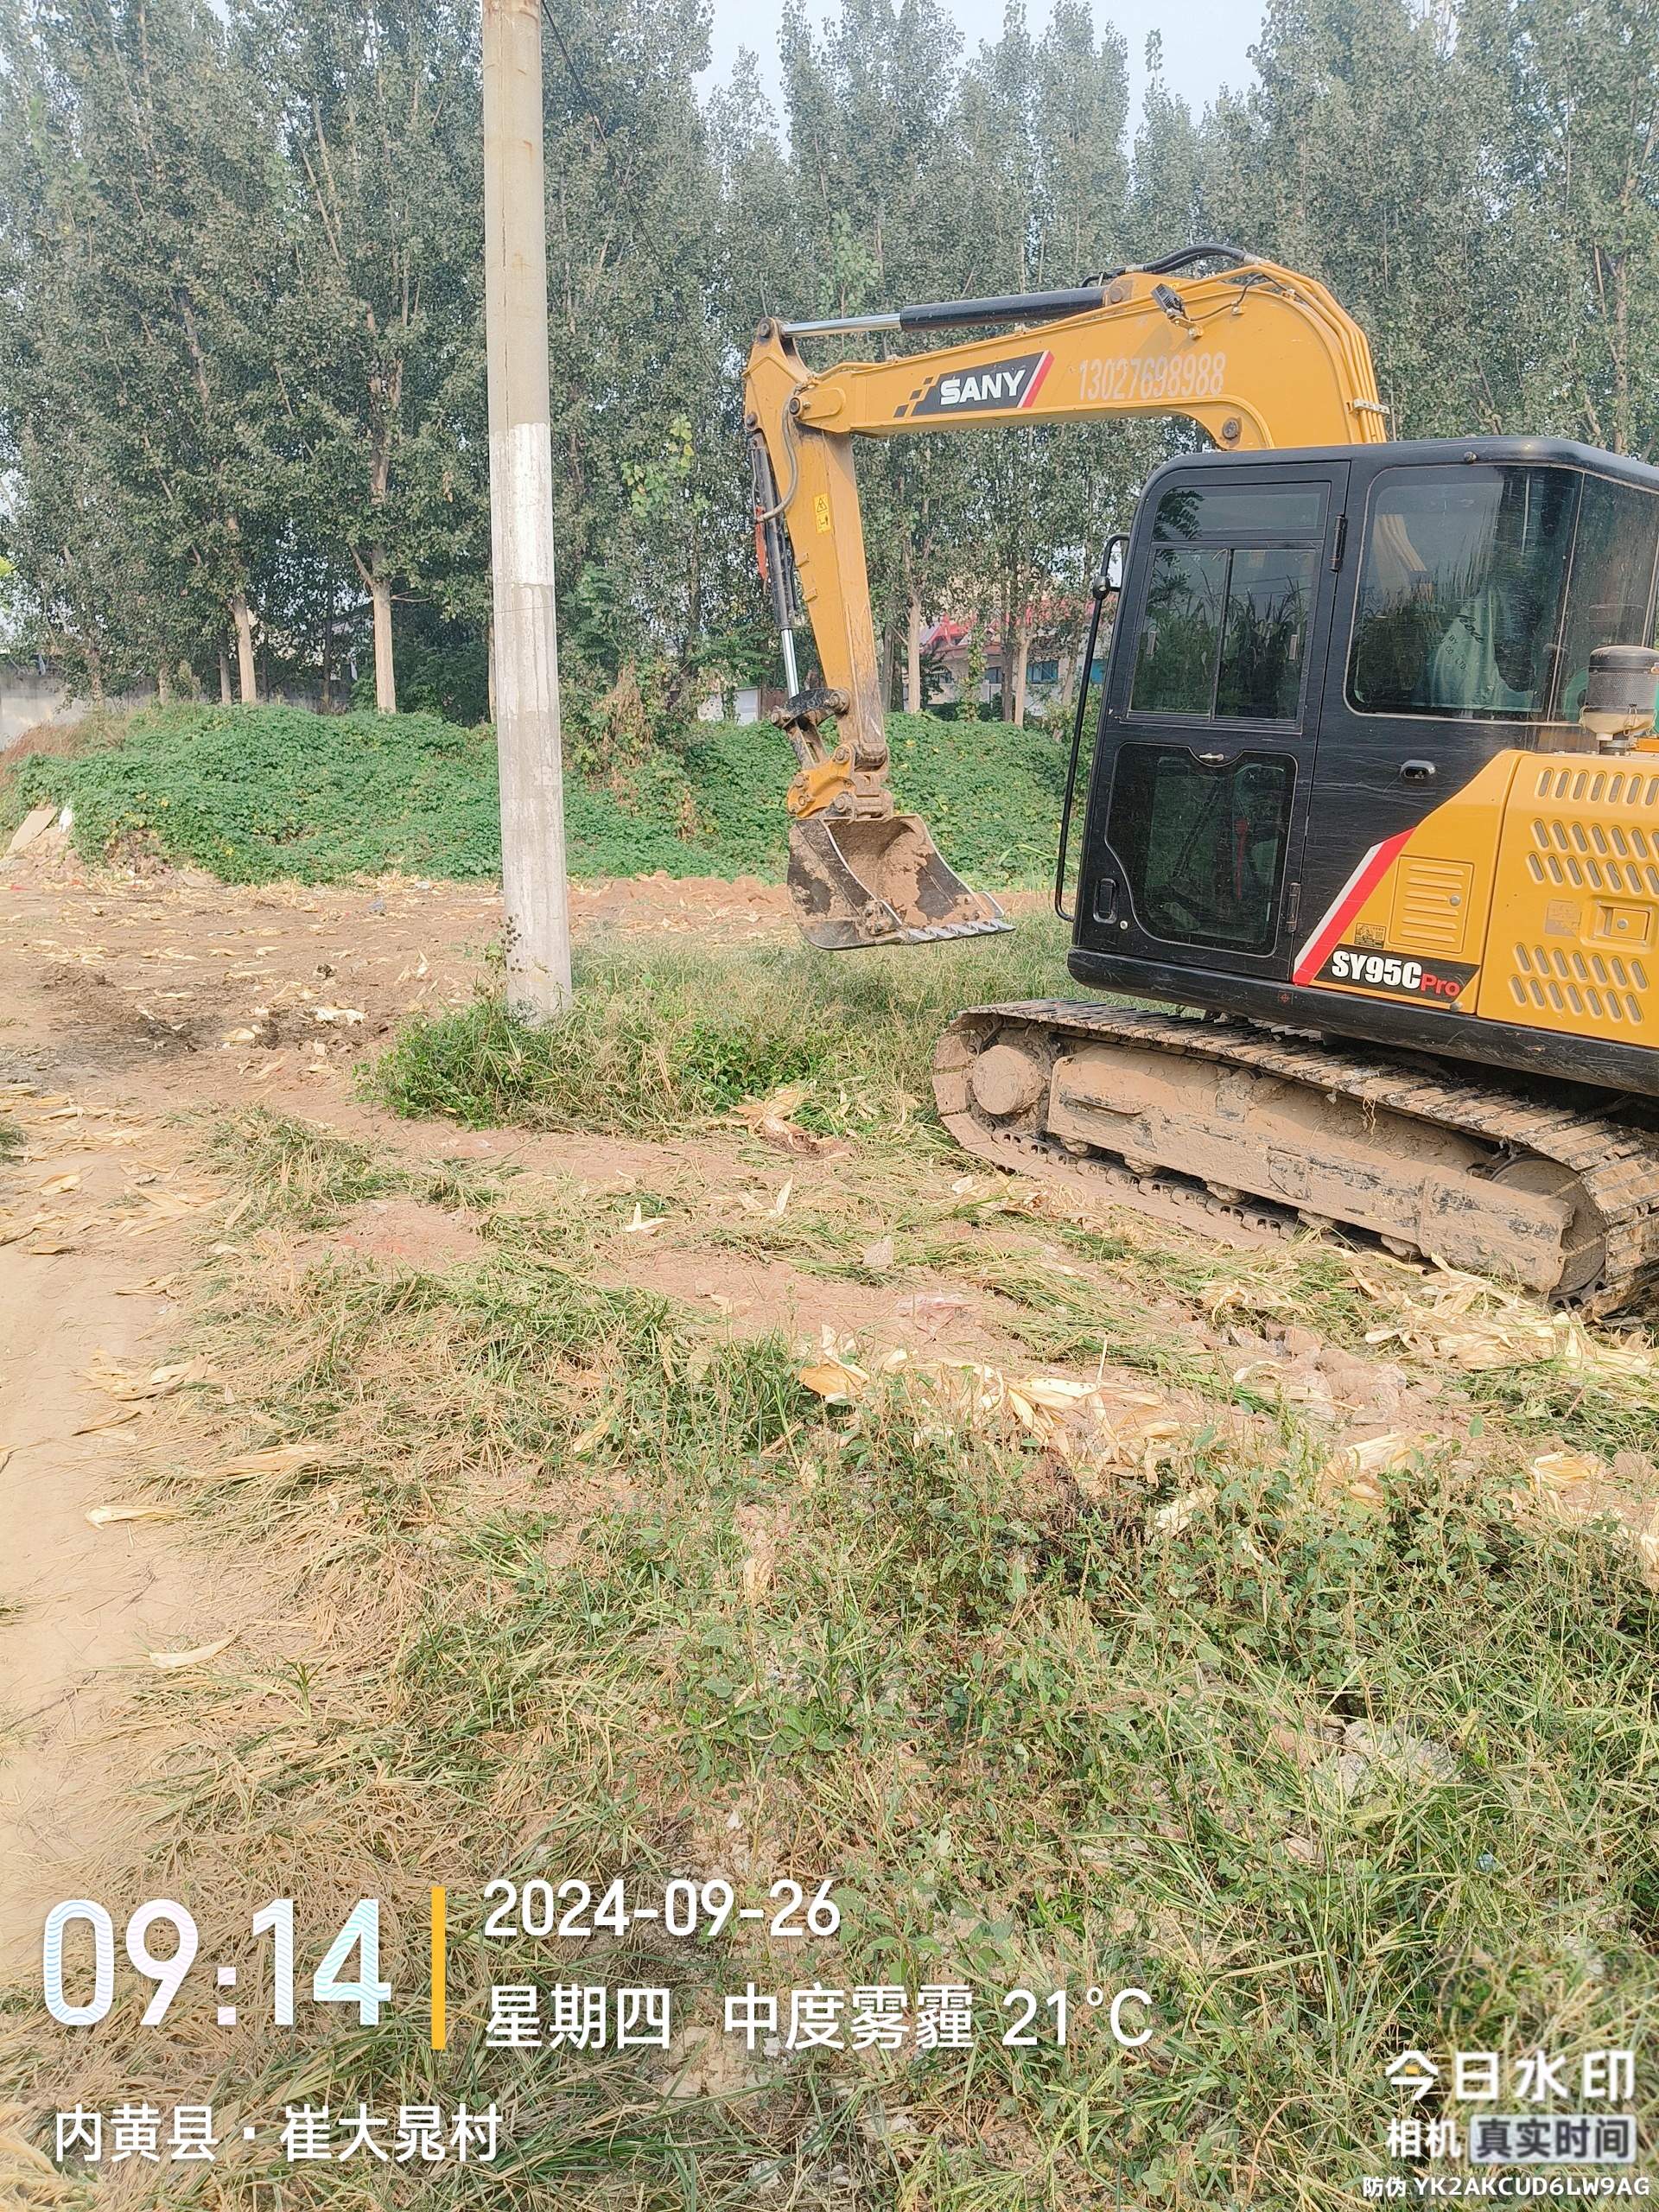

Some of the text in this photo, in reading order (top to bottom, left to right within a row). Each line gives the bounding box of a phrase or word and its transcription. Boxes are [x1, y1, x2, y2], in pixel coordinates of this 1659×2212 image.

[940, 369, 1026, 405] SANY
[1079, 352, 1226, 401] 13027698988
[1332, 950, 1460, 996] SY95C Pro
